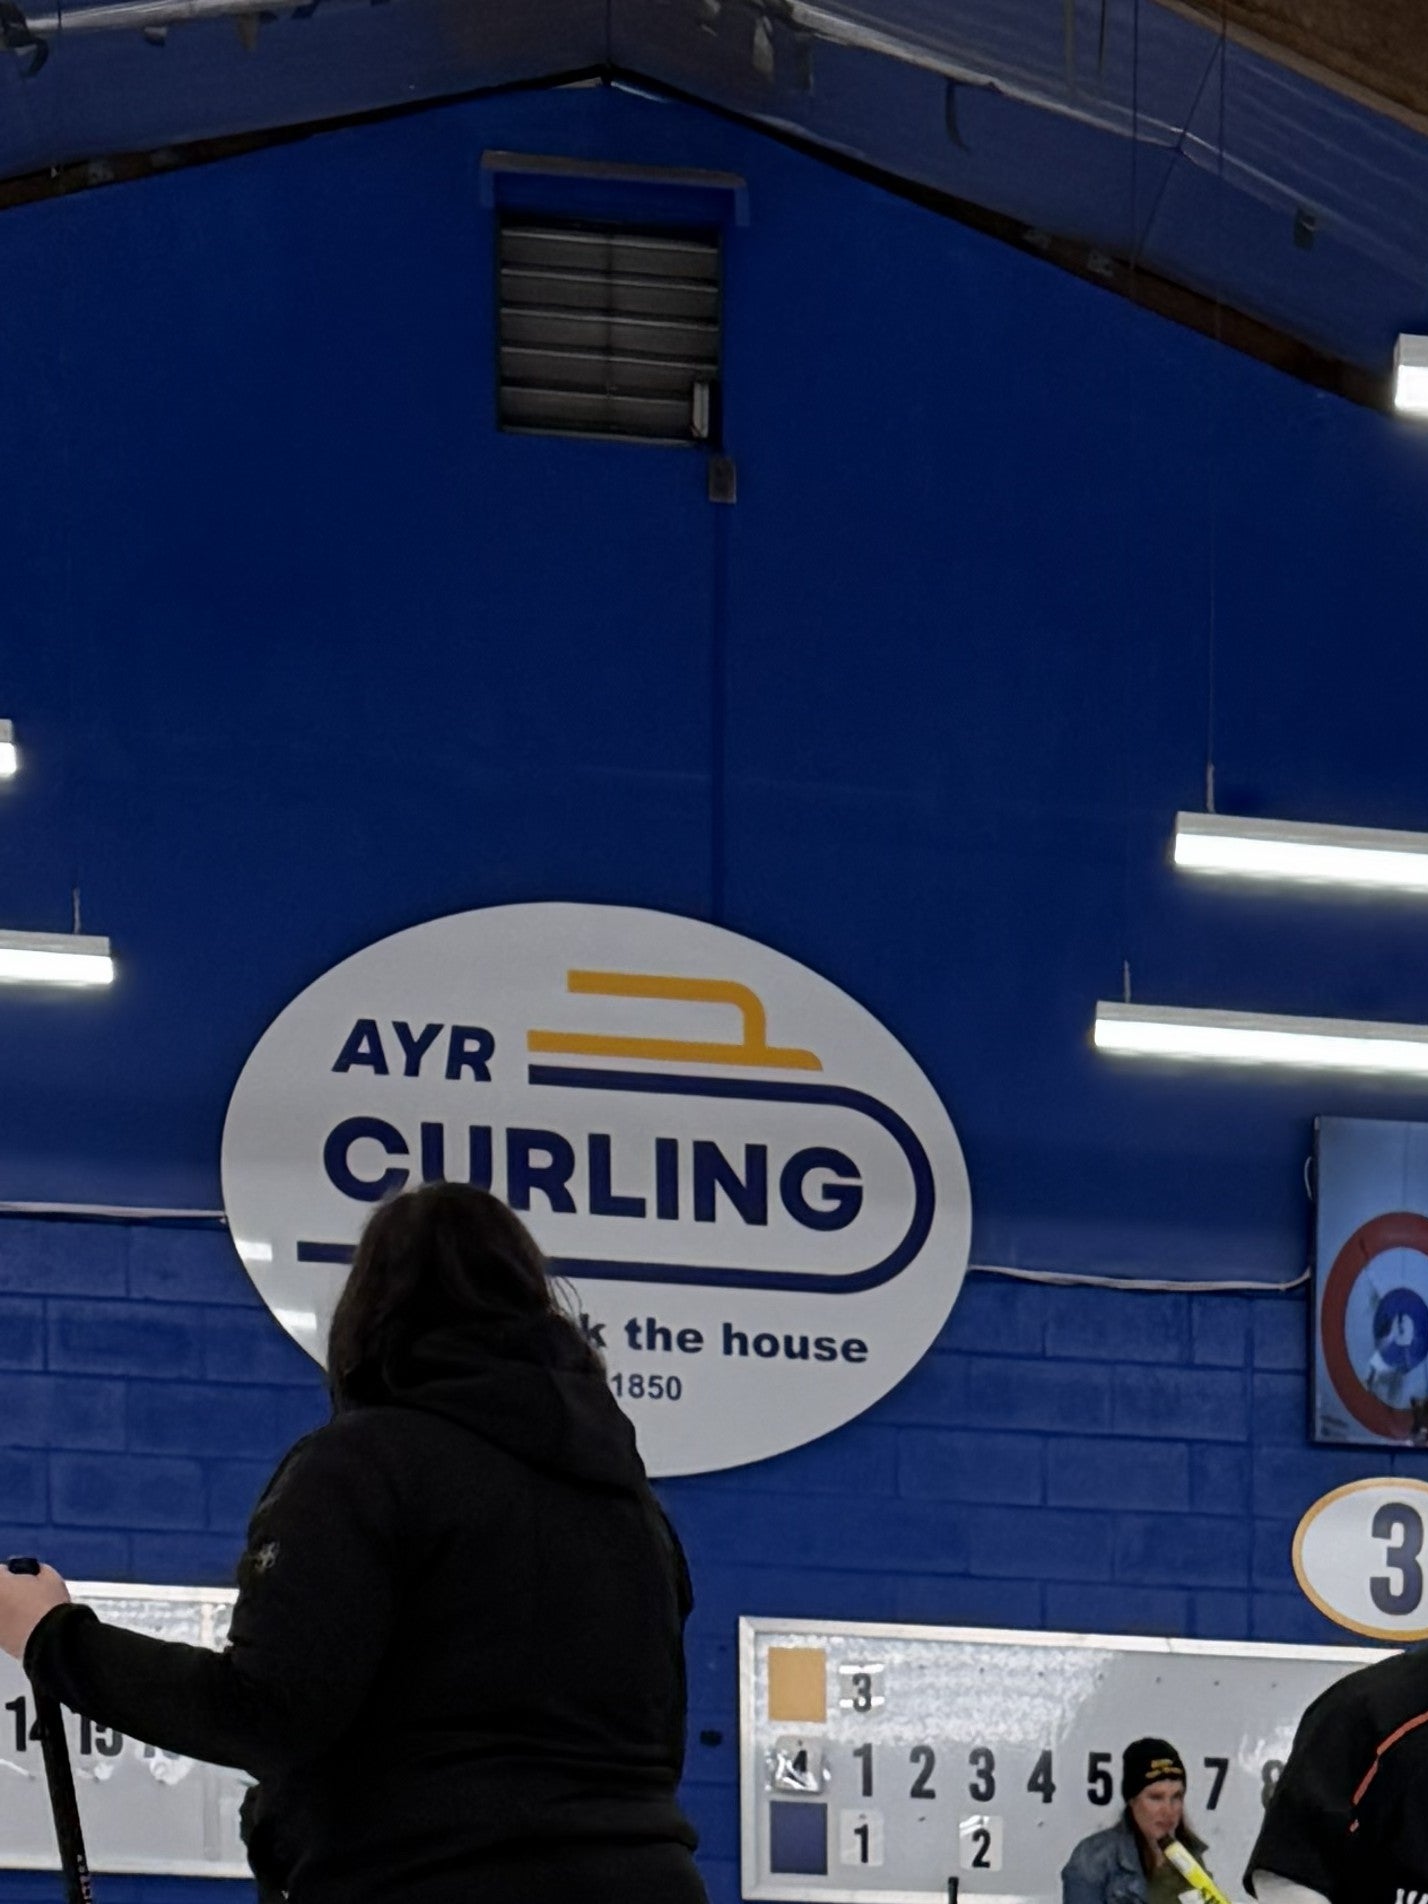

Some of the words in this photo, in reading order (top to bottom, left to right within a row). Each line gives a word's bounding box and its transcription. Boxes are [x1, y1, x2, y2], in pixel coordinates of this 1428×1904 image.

[332, 1018, 496, 1082] AYR
[322, 1115, 864, 1232] CURLING
[623, 1317, 704, 1354] the
[722, 1321, 869, 1364] house
[611, 1372, 682, 1401] 1850
[1369, 1502, 1424, 1616] 3
[852, 1672, 872, 1712] 3
[853, 1743, 873, 1797] 1
[910, 1746, 936, 1800] 2
[969, 1749, 996, 1803] 3
[1027, 1751, 1056, 1804] 4
[1087, 1752, 1114, 1807] 5
[1203, 1756, 1230, 1811] 7
[854, 1824, 870, 1865] 1
[972, 1828, 991, 1869] 2
